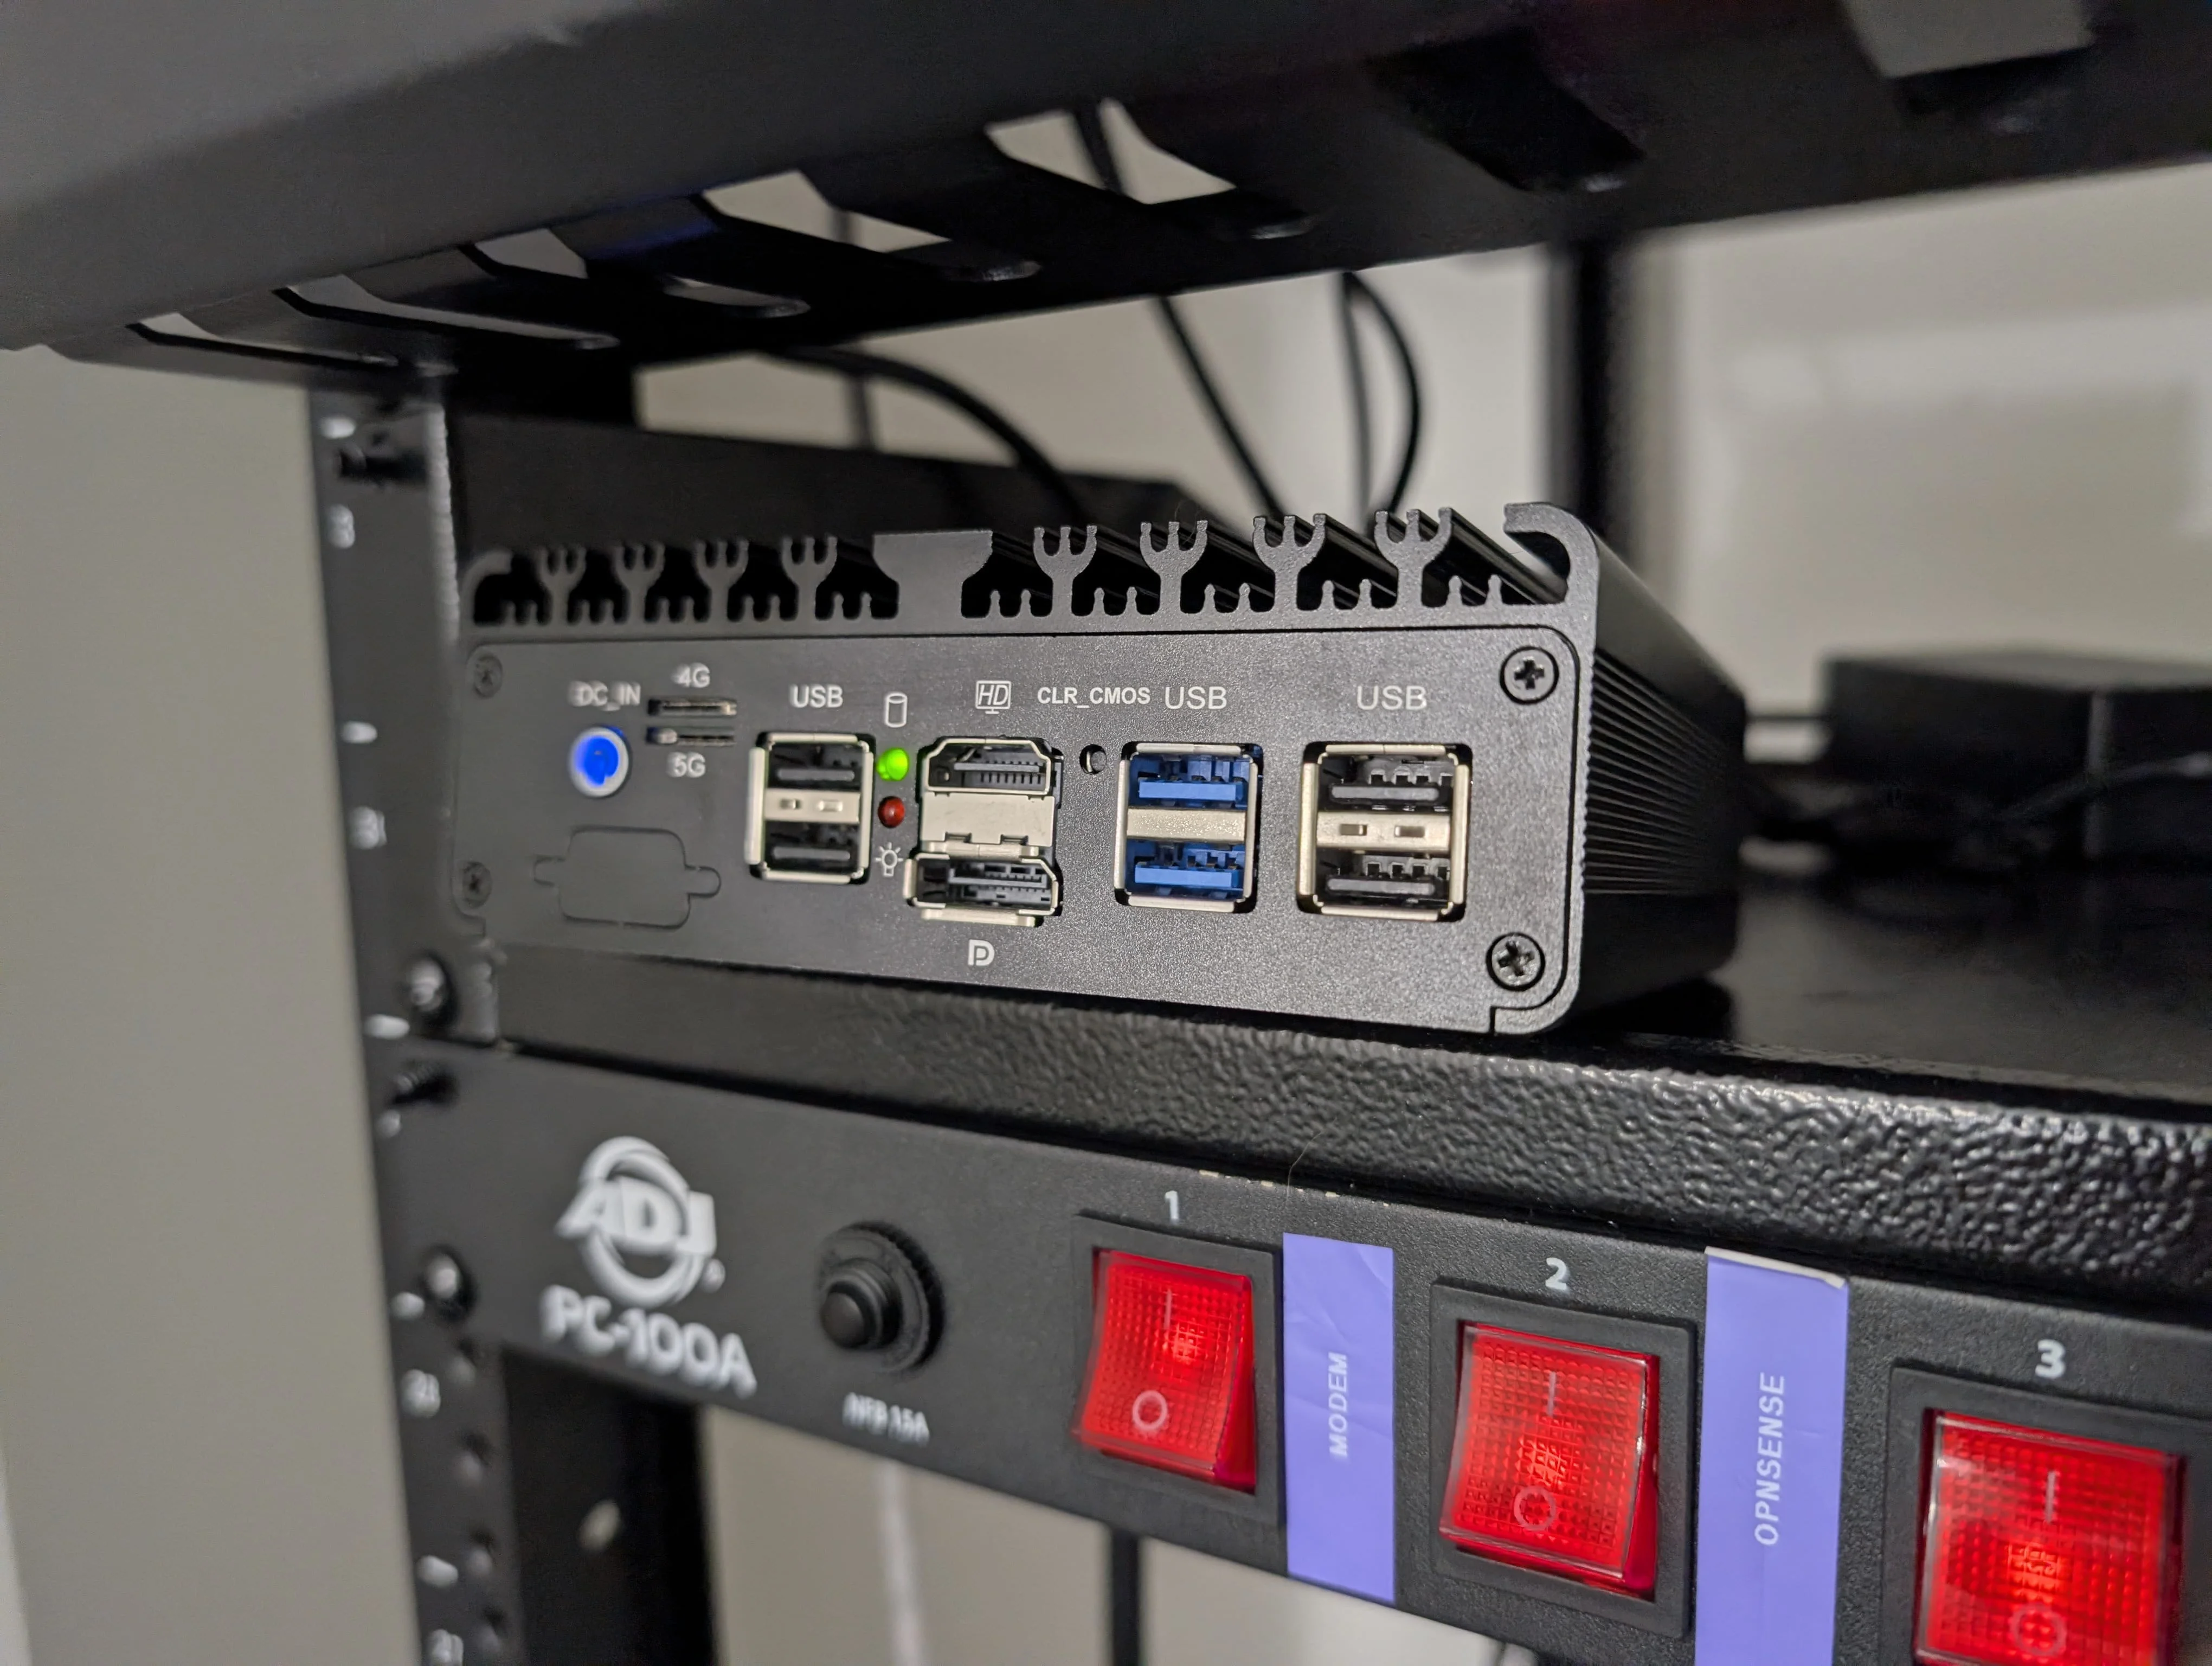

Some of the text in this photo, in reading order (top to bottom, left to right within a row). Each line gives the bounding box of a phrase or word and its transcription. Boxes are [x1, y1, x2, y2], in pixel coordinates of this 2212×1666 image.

[672, 662, 710, 688] 4G
[568, 680, 641, 711] DC_IN
[789, 684, 844, 708] USB
[978, 685, 1008, 705] HD
[1038, 687, 1151, 709] CLR_CMOS
[1165, 685, 1227, 710] USB
[1356, 685, 1427, 710] USB
[666, 752, 705, 778] 5G
[1163, 1190, 1179, 1221] 1
[1545, 1257, 1568, 1290] 2
[541, 1284, 757, 1398] PC-100A
[2035, 1338, 2066, 1379] 3
[1328, 1351, 1348, 1459] MODEM
[1754, 1372, 1786, 1547] OPNSENSE
